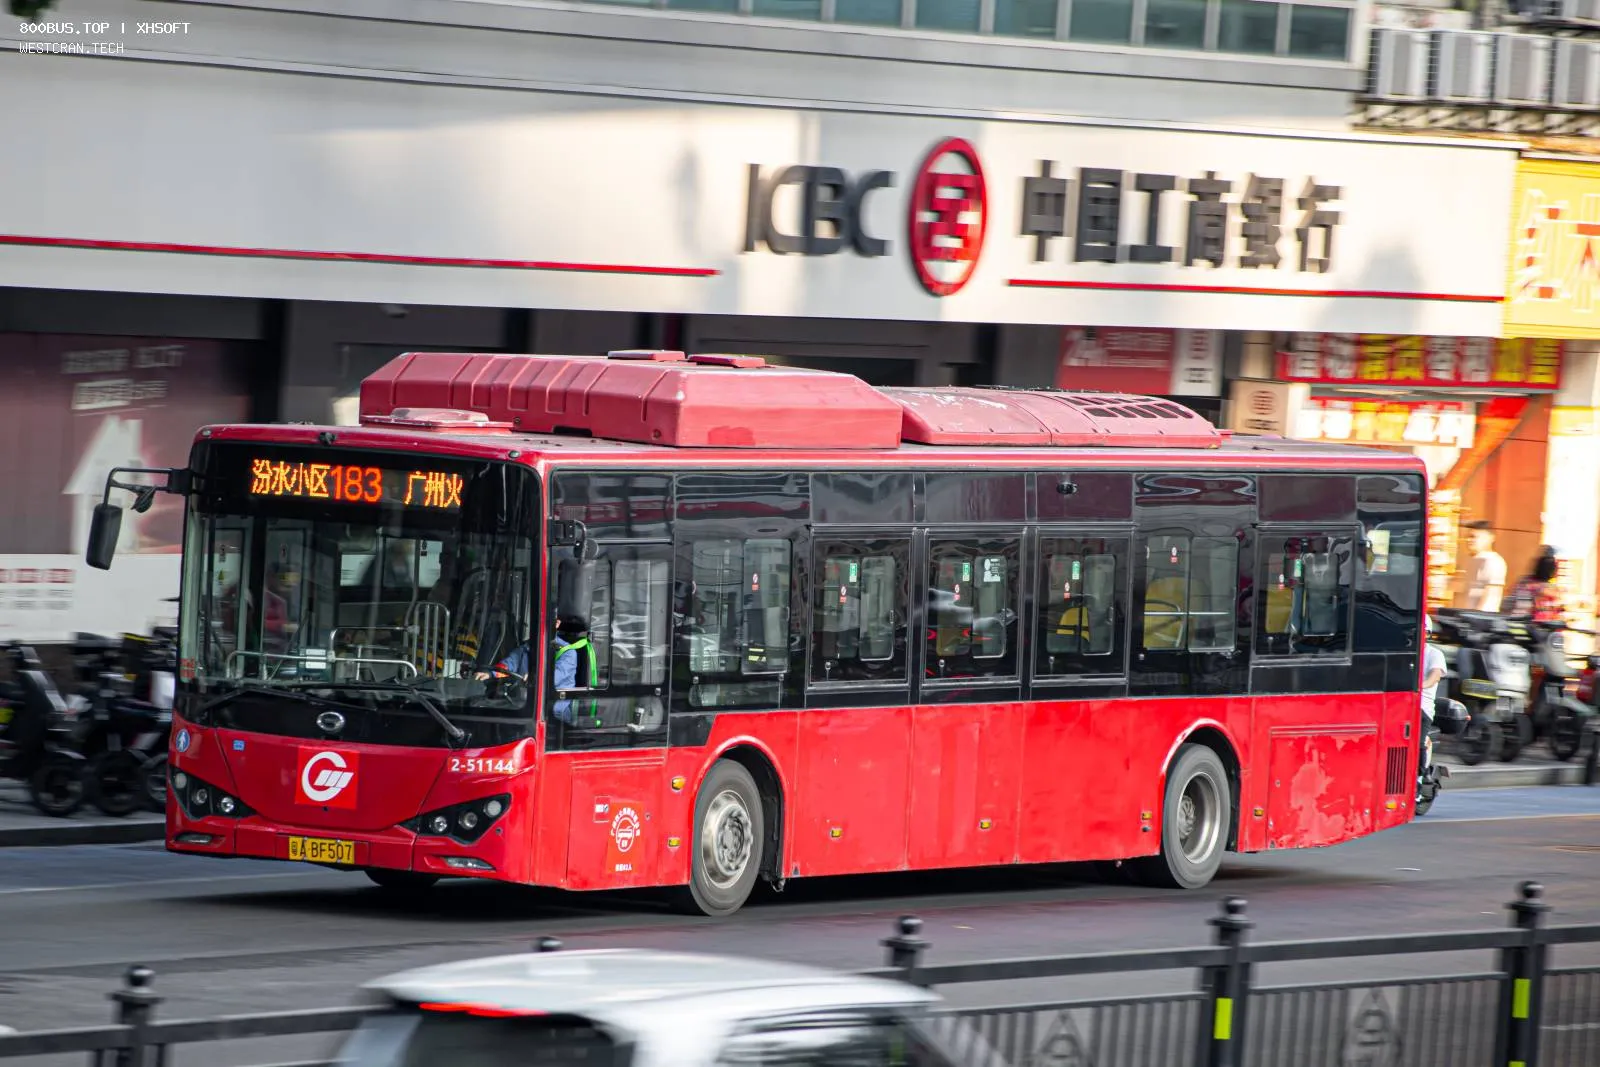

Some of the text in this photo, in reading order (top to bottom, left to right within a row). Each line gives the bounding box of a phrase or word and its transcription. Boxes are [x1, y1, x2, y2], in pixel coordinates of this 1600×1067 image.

[741, 163, 894, 257] ICBC
[1020, 159, 1342, 274] 中国工商银行
[252, 458, 463, 508] 汾水小区 183 广州火
[450, 757, 515, 773] 2-51144
